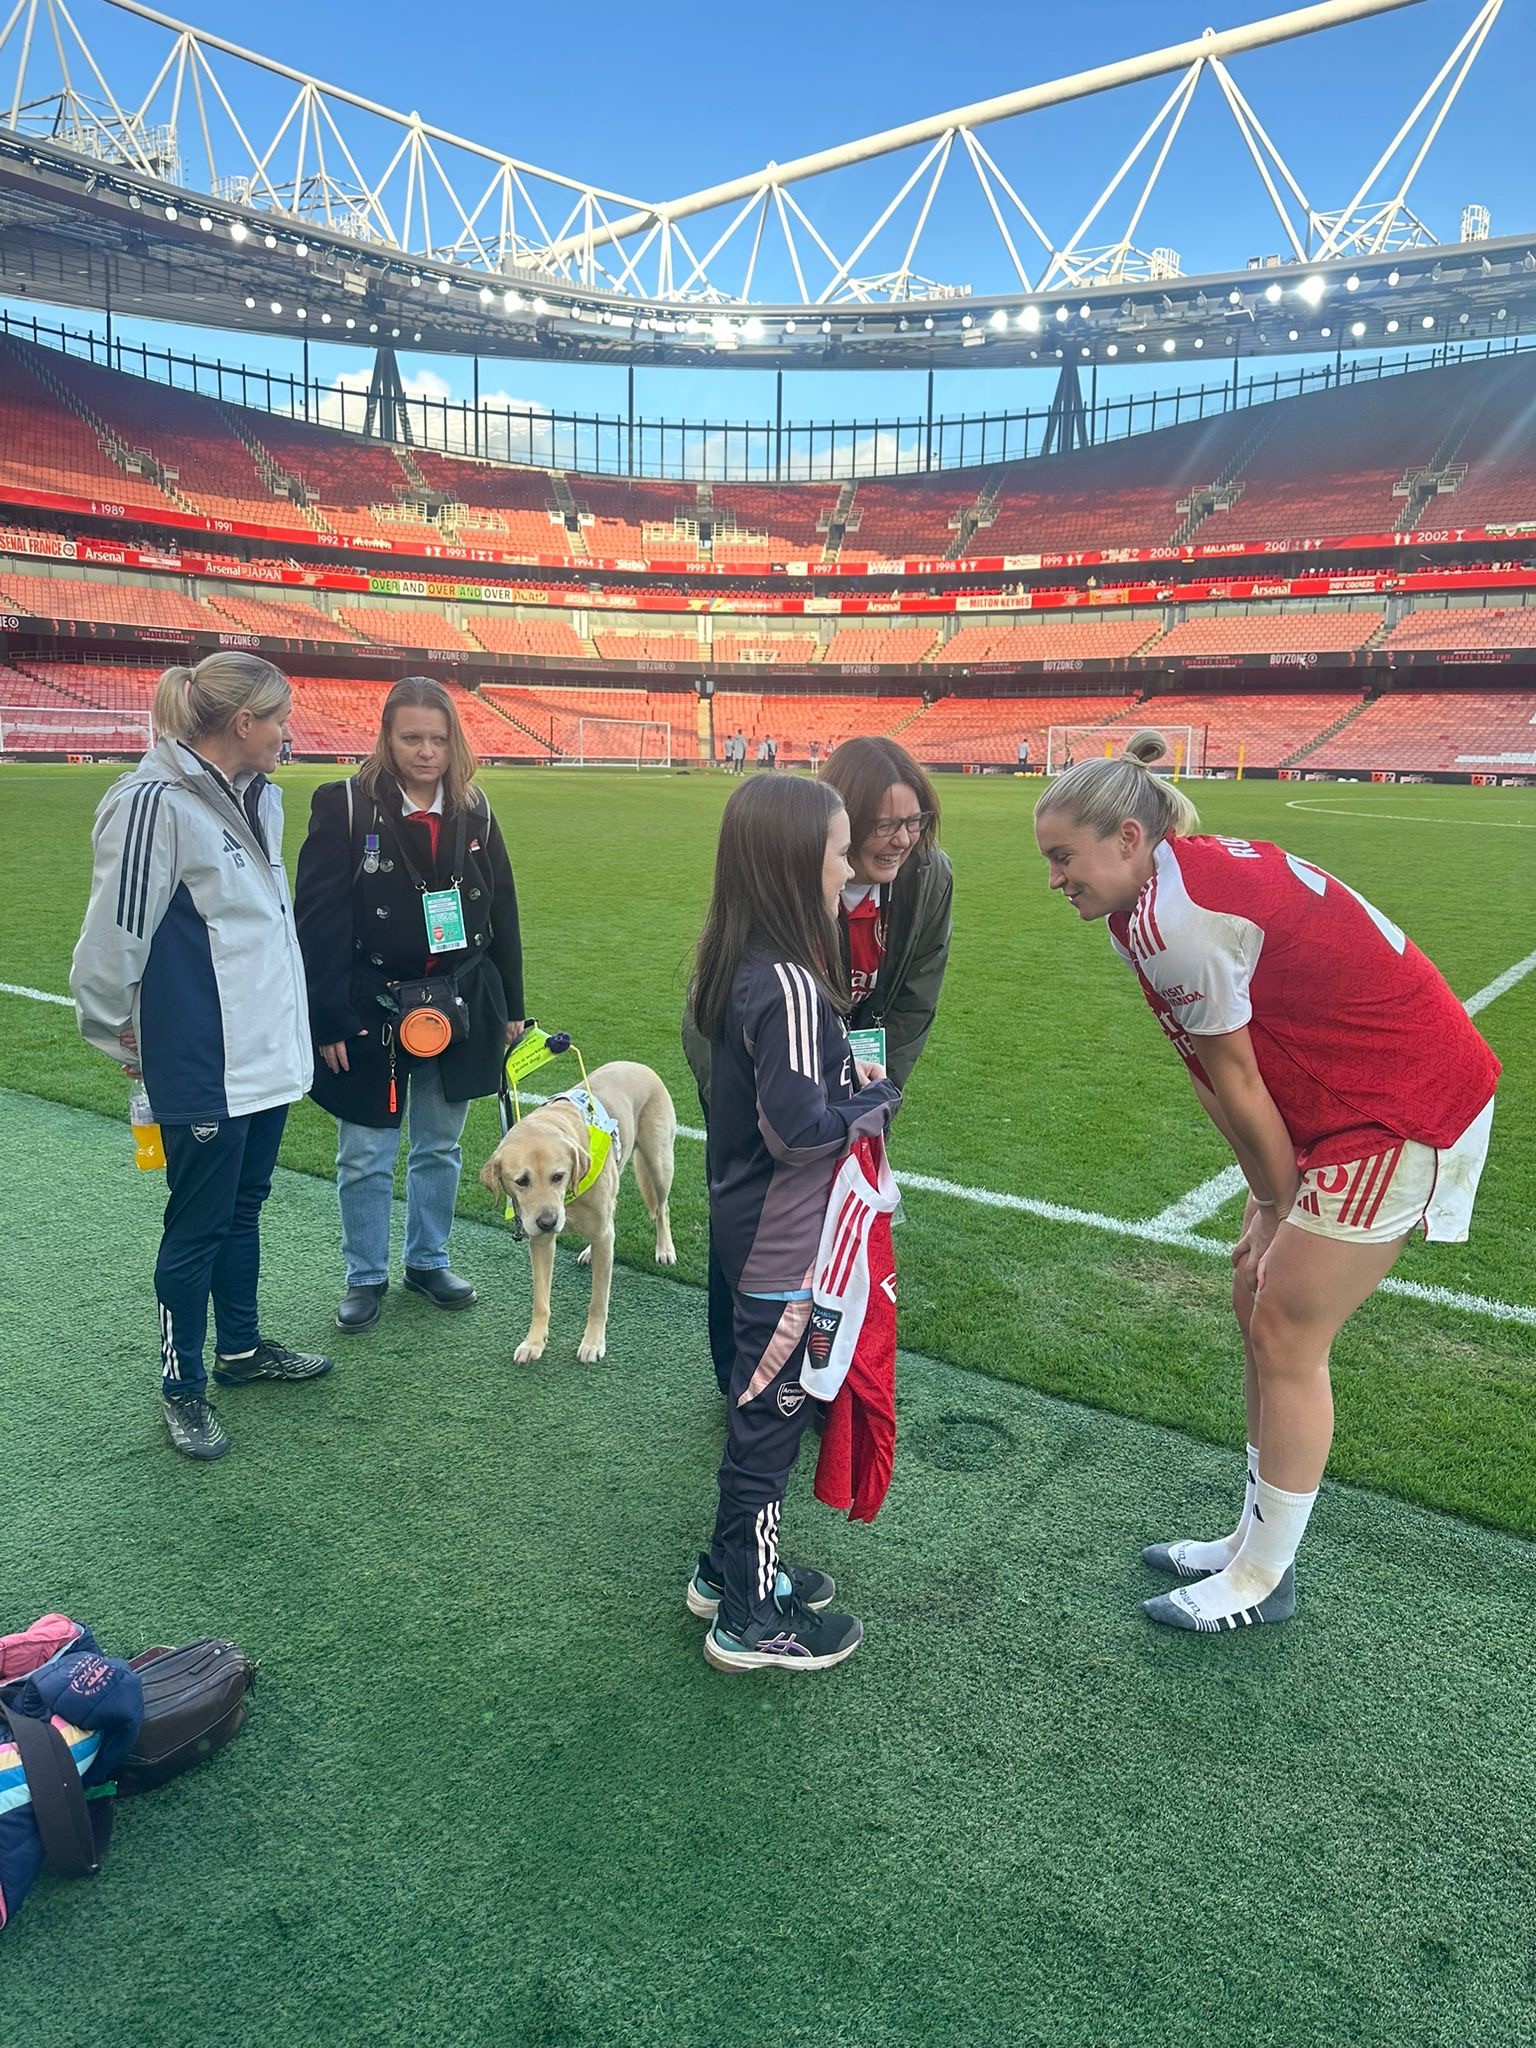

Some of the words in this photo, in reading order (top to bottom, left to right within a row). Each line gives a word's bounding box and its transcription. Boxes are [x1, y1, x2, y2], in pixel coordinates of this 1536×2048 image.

[100, 503, 125, 516] 1989
[214, 520, 233, 532] 1991
[317, 534, 339, 545] 1992
[1417, 530, 1449, 543] 2002
[29, 541, 62, 557] FRANCE
[446, 547, 467, 557] 1993
[1150, 547, 1180, 558] 2000
[1203, 543, 1246, 554] MALAYSIA
[85, 547, 125, 563] Arsenal
[1042, 556, 1063, 566] 1999
[573, 557, 594, 566] 1994
[206, 561, 241, 576] Arsenal
[247, 567, 282, 580] JAPAN
[813, 564, 833, 573] 1997
[371, 579, 399, 591] OVER
[403, 581, 425, 594] AND
[428, 583, 456, 595] OVER
[459, 586, 481, 597] AND
[484, 588, 511, 599] OVER
[1250, 582, 1291, 596] Arsenal
[866, 600, 901, 612] Arsenal
[970, 598, 1000, 609] MILTON
[1001, 597, 1031, 608] KEYNES
[219, 634, 252, 646] BOYZONE
[428, 649, 461, 661] BOYZONE
[1270, 653, 1308, 665] BOYZONE
[636, 661, 668, 671] BOYZONE
[841, 664, 872, 674] BOYZONE
[1043, 660, 1074, 671] BOYZONE
